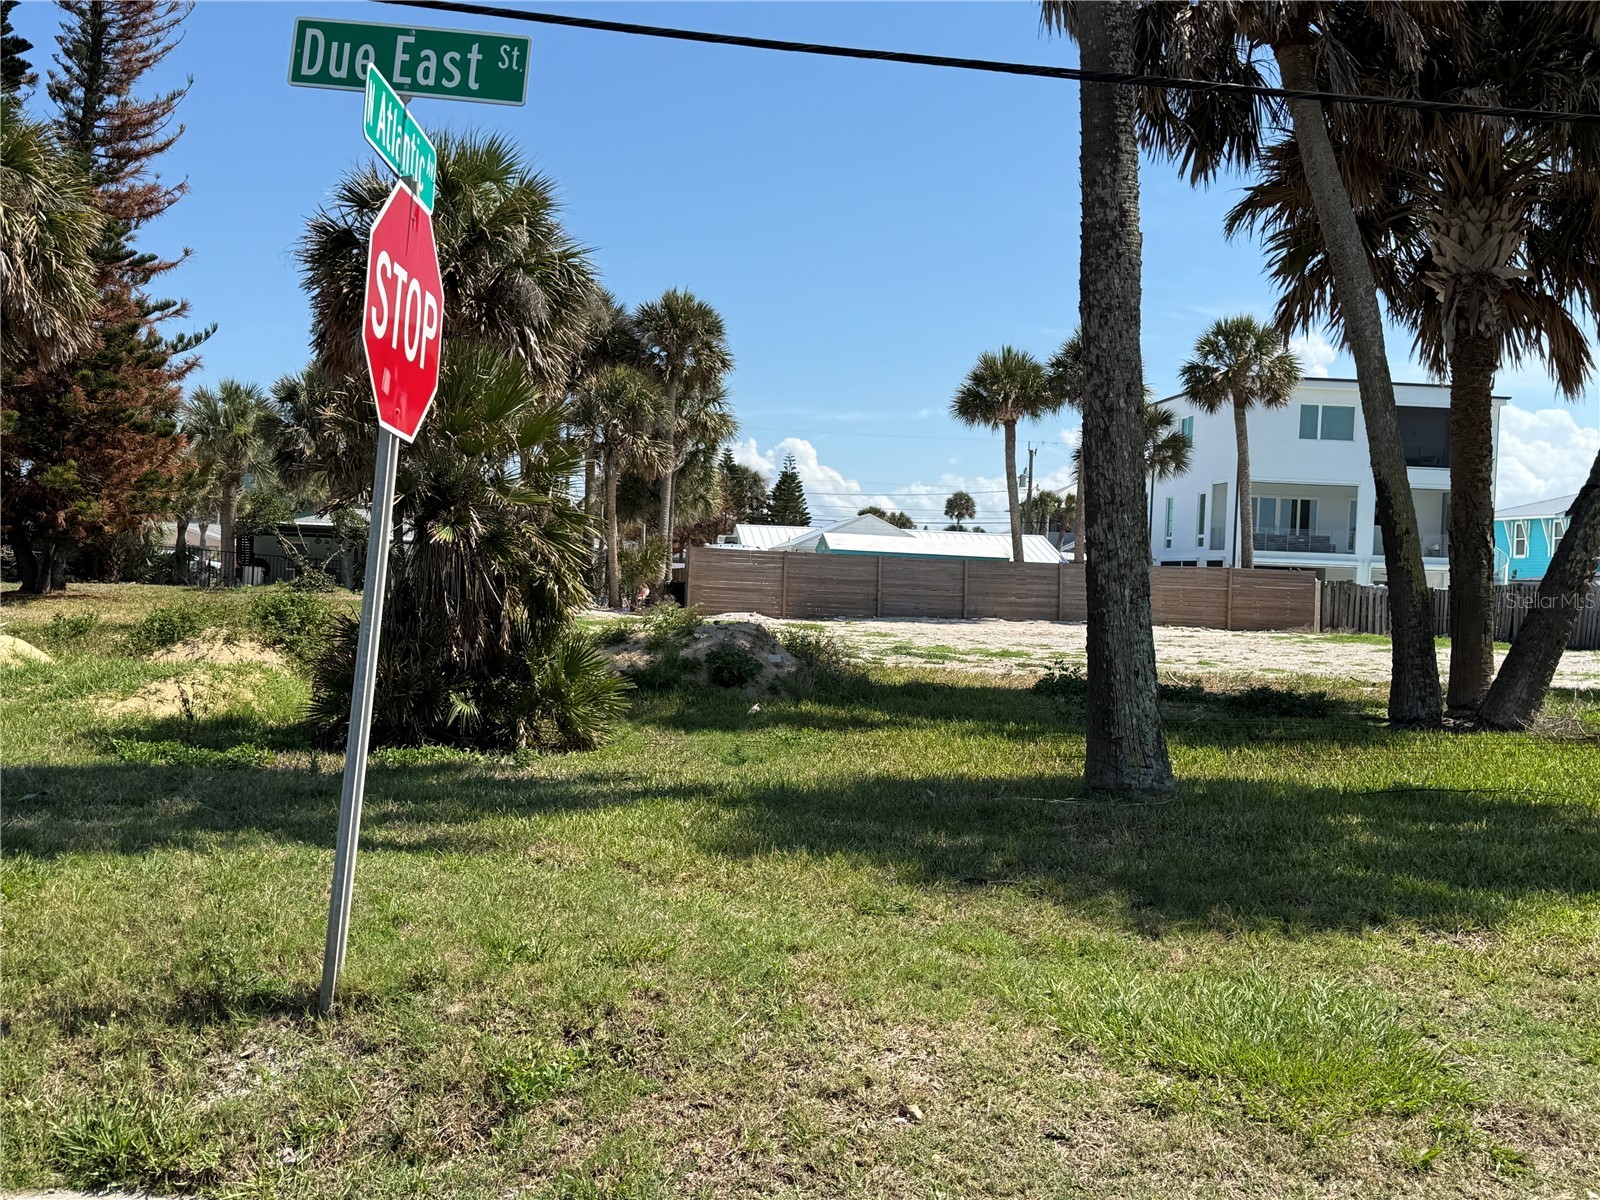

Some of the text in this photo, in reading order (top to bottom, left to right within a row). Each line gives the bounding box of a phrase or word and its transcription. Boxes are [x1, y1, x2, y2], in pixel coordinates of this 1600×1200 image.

[301, 27, 523, 90] Due East St.
[367, 79, 375, 126] N
[376, 91, 425, 192] Atlantic
[371, 250, 438, 370] STOP
